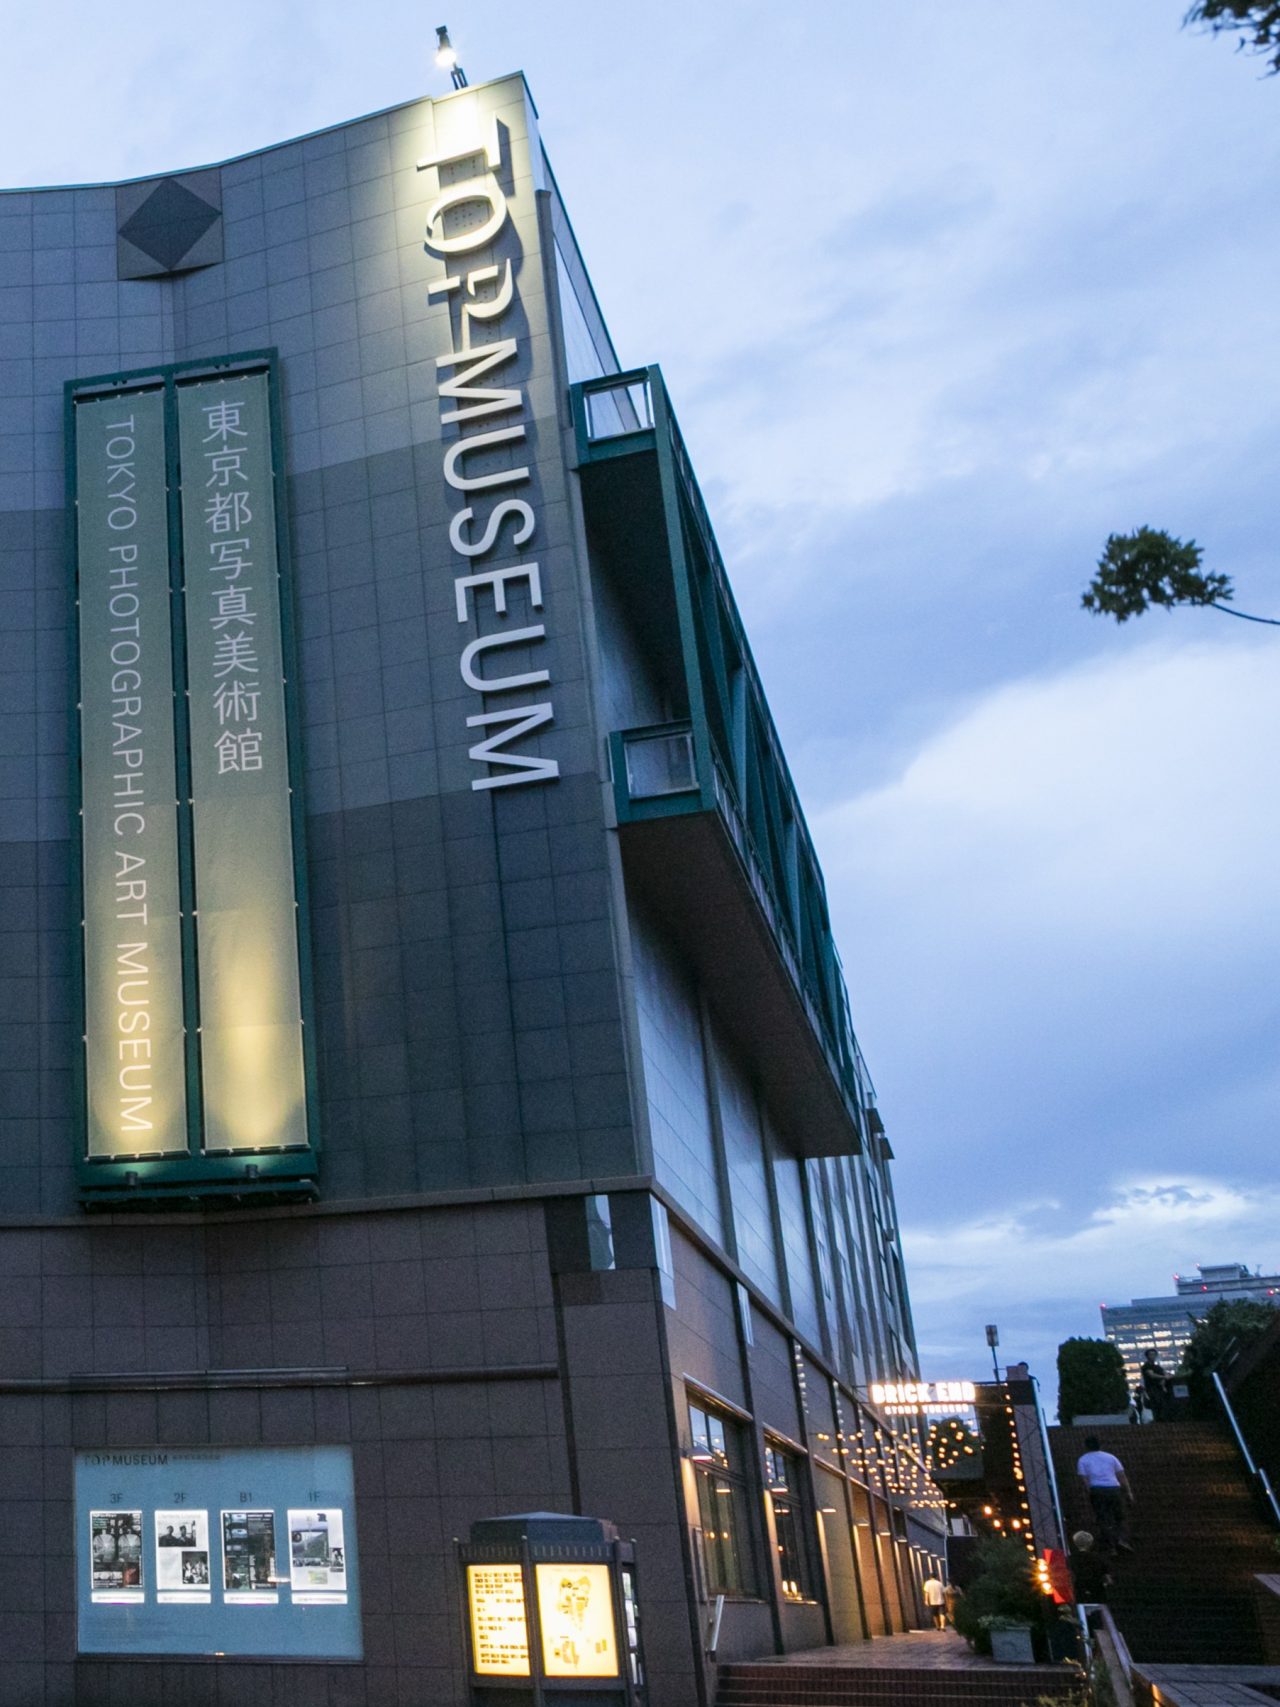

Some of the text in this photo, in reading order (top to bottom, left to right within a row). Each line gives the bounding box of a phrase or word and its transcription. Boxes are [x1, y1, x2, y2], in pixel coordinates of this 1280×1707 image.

[201, 400, 264, 775] 東京都写真美術館
[436, 337, 561, 791] MUSEUM
[105, 413, 154, 1133] TOKYO PHOTOGRAPHIC ART MUSEUM
[871, 1381, 976, 1404] BRICK END
